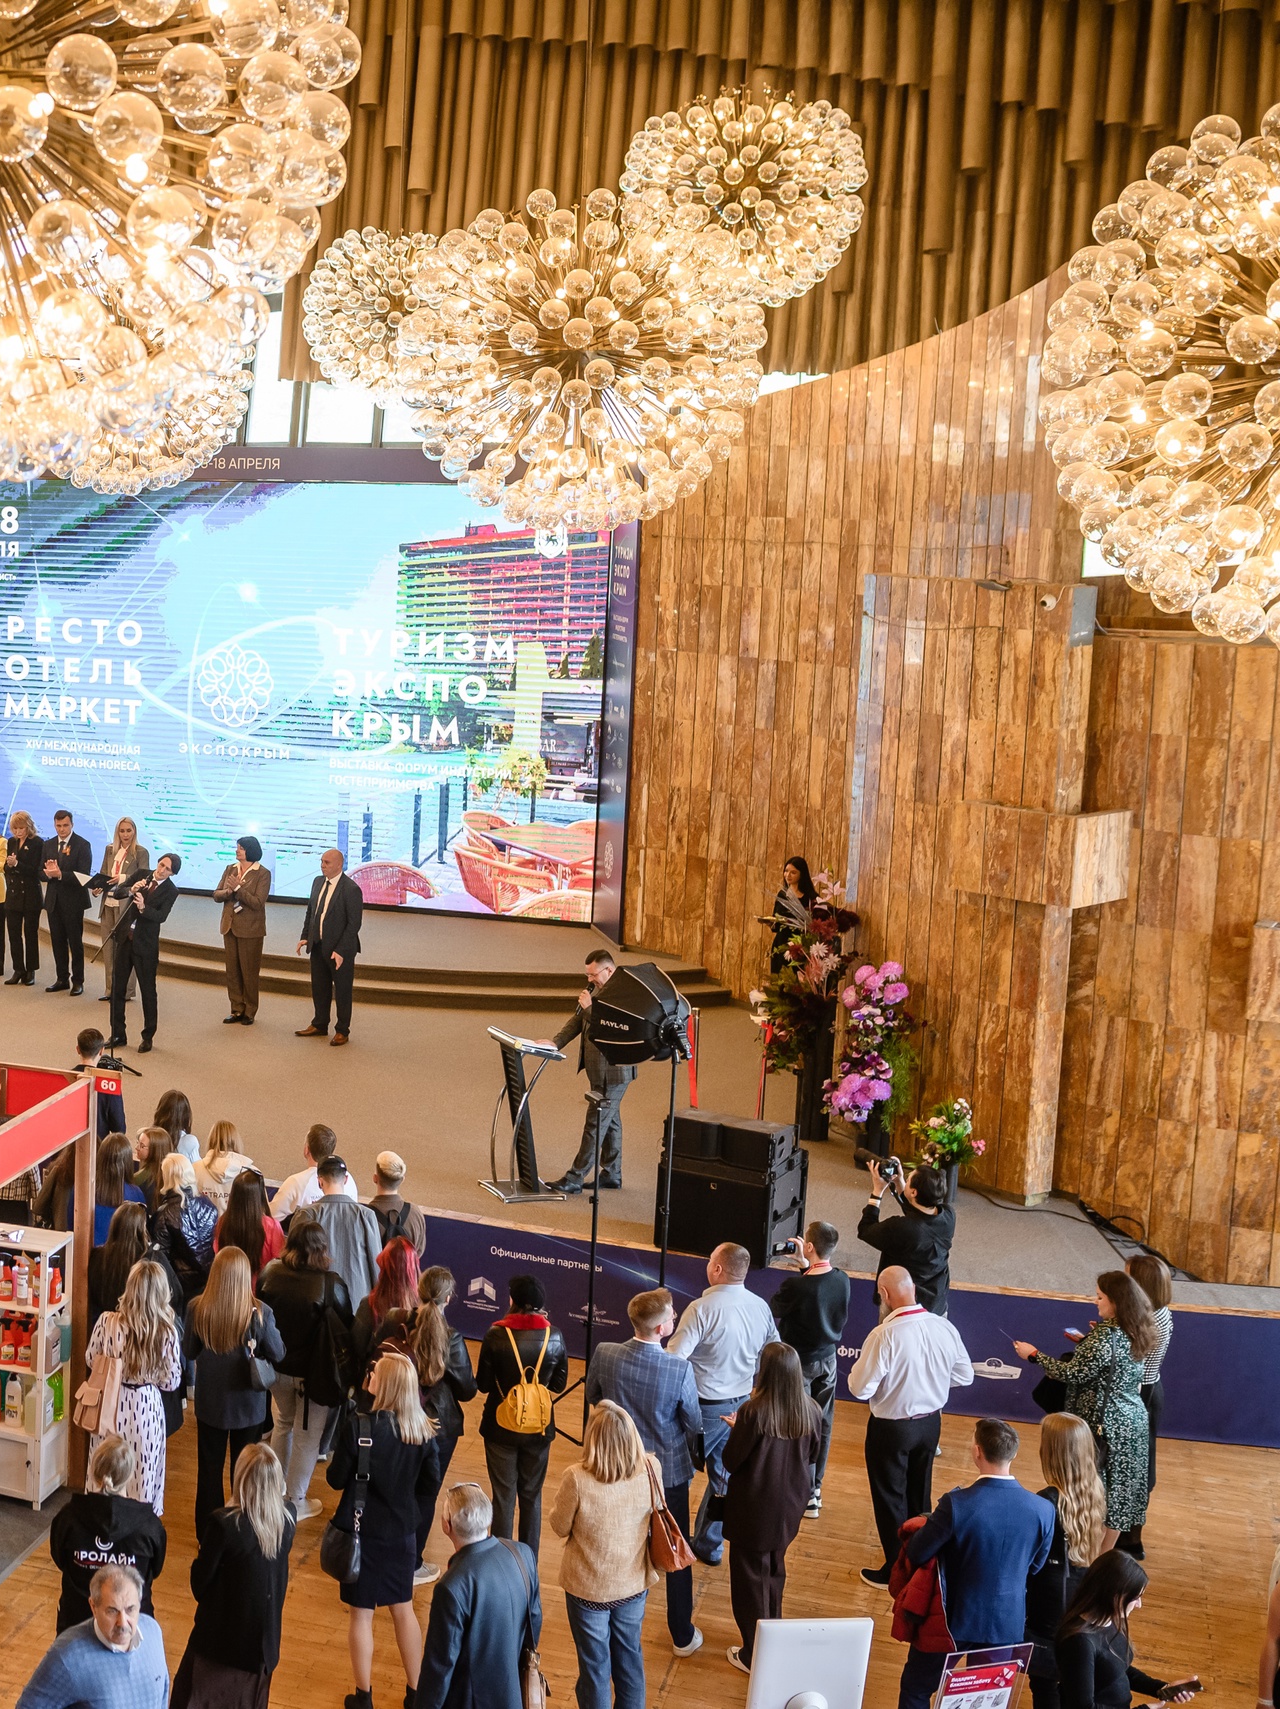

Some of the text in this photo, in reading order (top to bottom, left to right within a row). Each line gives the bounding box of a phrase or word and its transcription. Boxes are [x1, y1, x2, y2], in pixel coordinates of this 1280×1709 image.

[228, 457, 280, 470] АПРЕЛЯ
[6, 615, 143, 647] РЕСТО
[331, 627, 516, 664] ТУРИЗМ
[5, 654, 142, 686] ОТЕЛЬ
[332, 670, 488, 705] ЭКСПО
[4, 692, 142, 725] МАРКЕТ
[331, 710, 461, 746] КРЫМ
[26, 738, 141, 756] XIV МЕЖДУНАРОДНАЯ
[178, 742, 291, 760] ЭКСПОКРЫМ
[41, 756, 141, 772] ВЫСТАВКА HORECA
[329, 757, 513, 780] ВЫСТАВКА-ФОРУМ ИНДУСТРИИ
[328, 774, 435, 792] ГОСТЕПРИИМСТВА
[600, 1019, 629, 1031] RAYLAB
[100, 1079, 117, 1092] 60
[490, 1245, 603, 1273] Официальные партнеы
